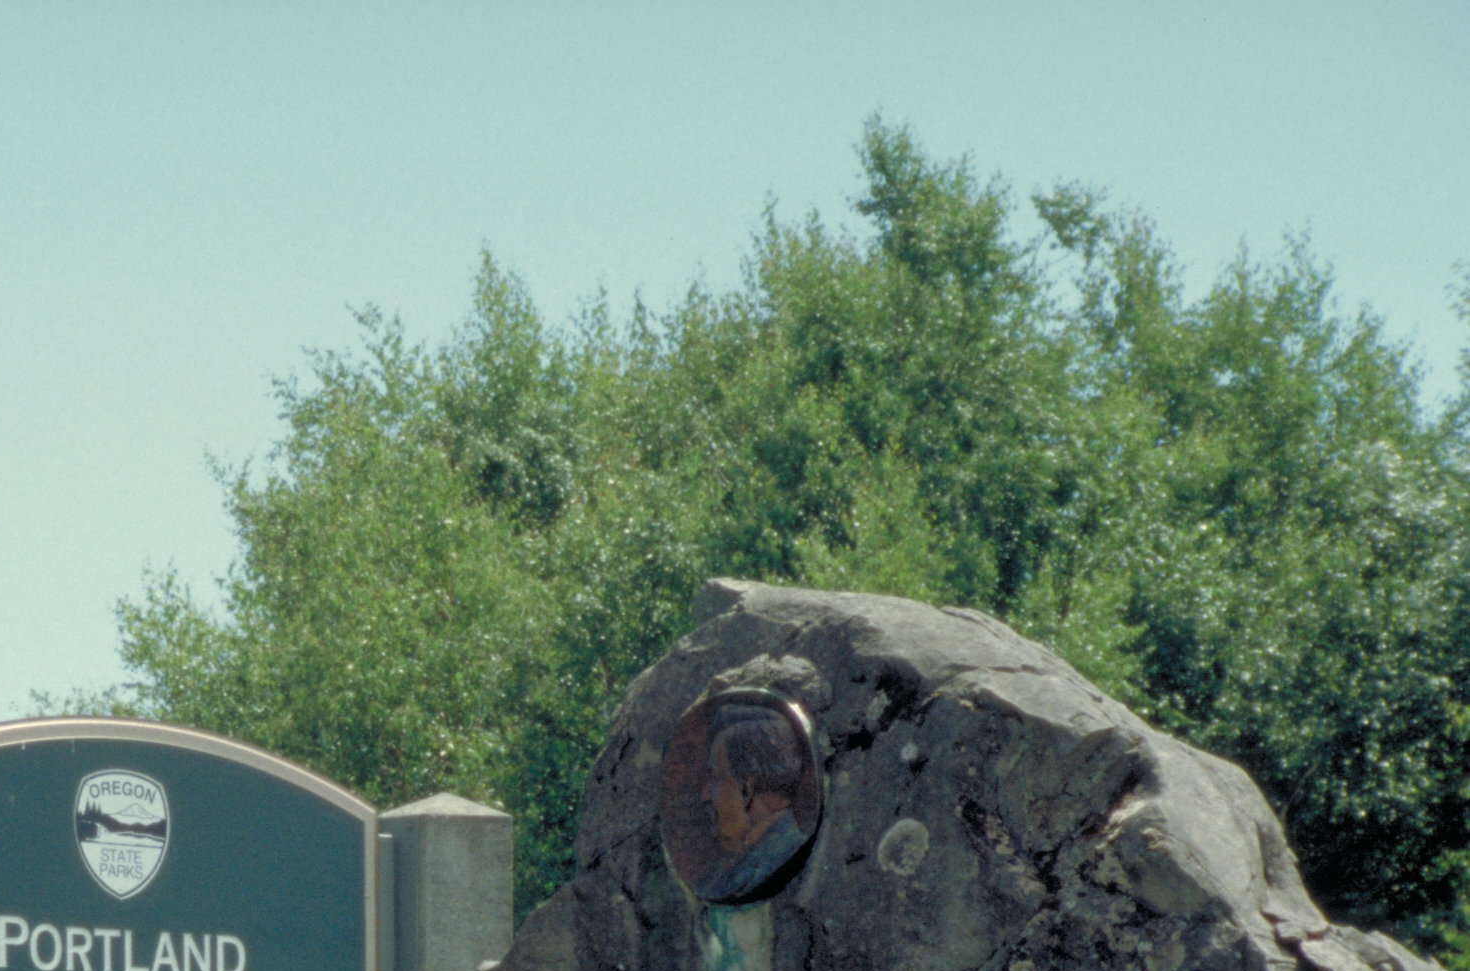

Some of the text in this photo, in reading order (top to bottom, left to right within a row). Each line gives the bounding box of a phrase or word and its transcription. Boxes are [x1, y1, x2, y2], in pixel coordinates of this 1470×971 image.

[90, 781, 155, 804] OREGON
[101, 849, 142, 864] STATE
[101, 864, 142, 880] PARKS
